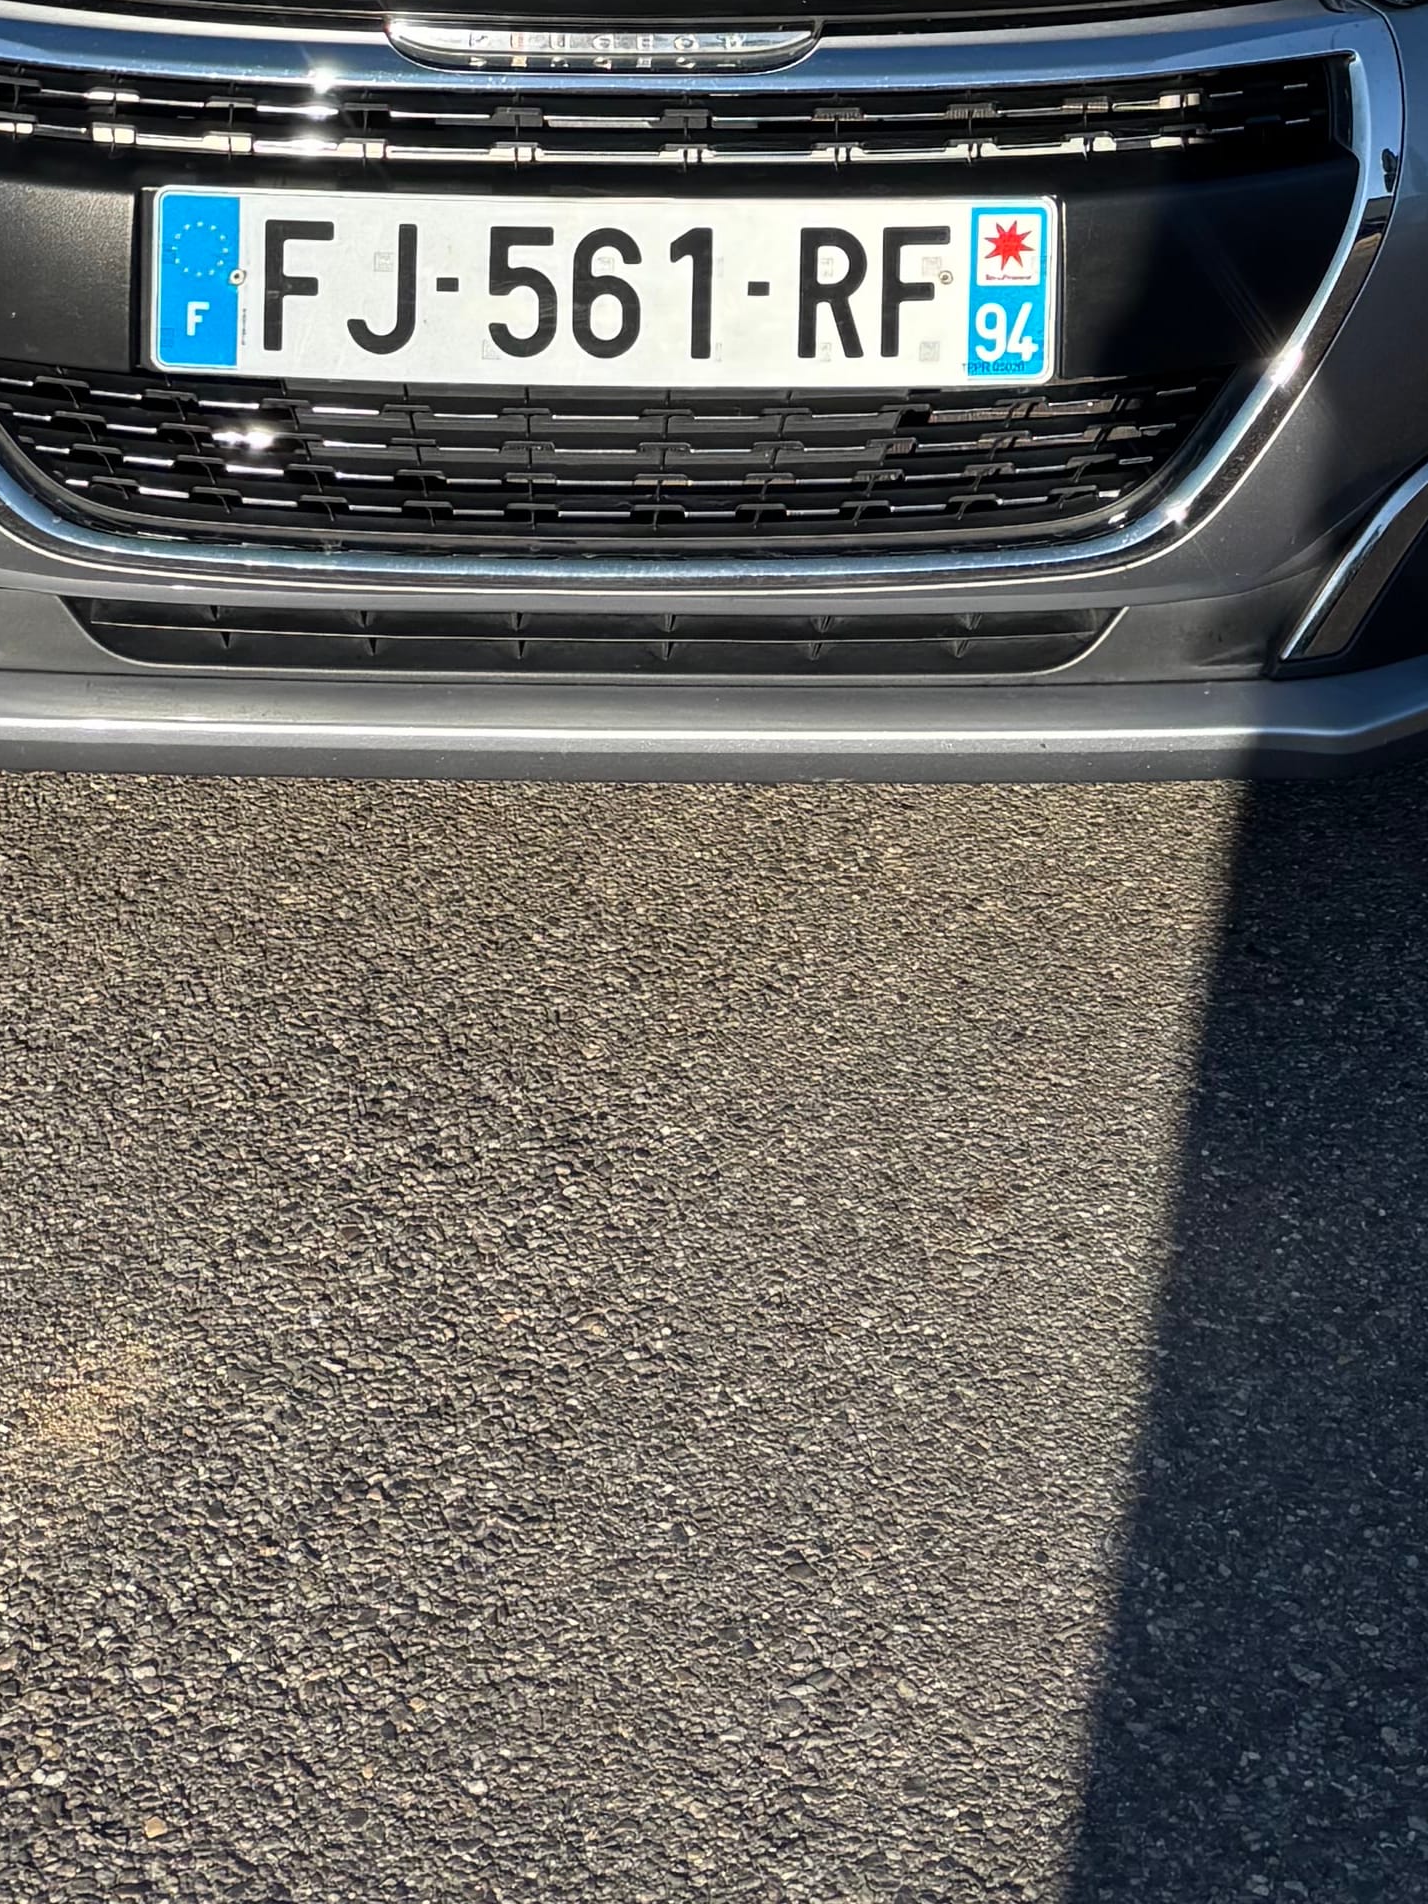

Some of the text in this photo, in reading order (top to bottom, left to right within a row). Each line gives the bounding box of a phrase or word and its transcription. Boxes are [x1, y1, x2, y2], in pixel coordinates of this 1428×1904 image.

[186, 301, 210, 336] F
[262, 219, 951, 360] FJ-561-RF
[975, 302, 1039, 362] 94
